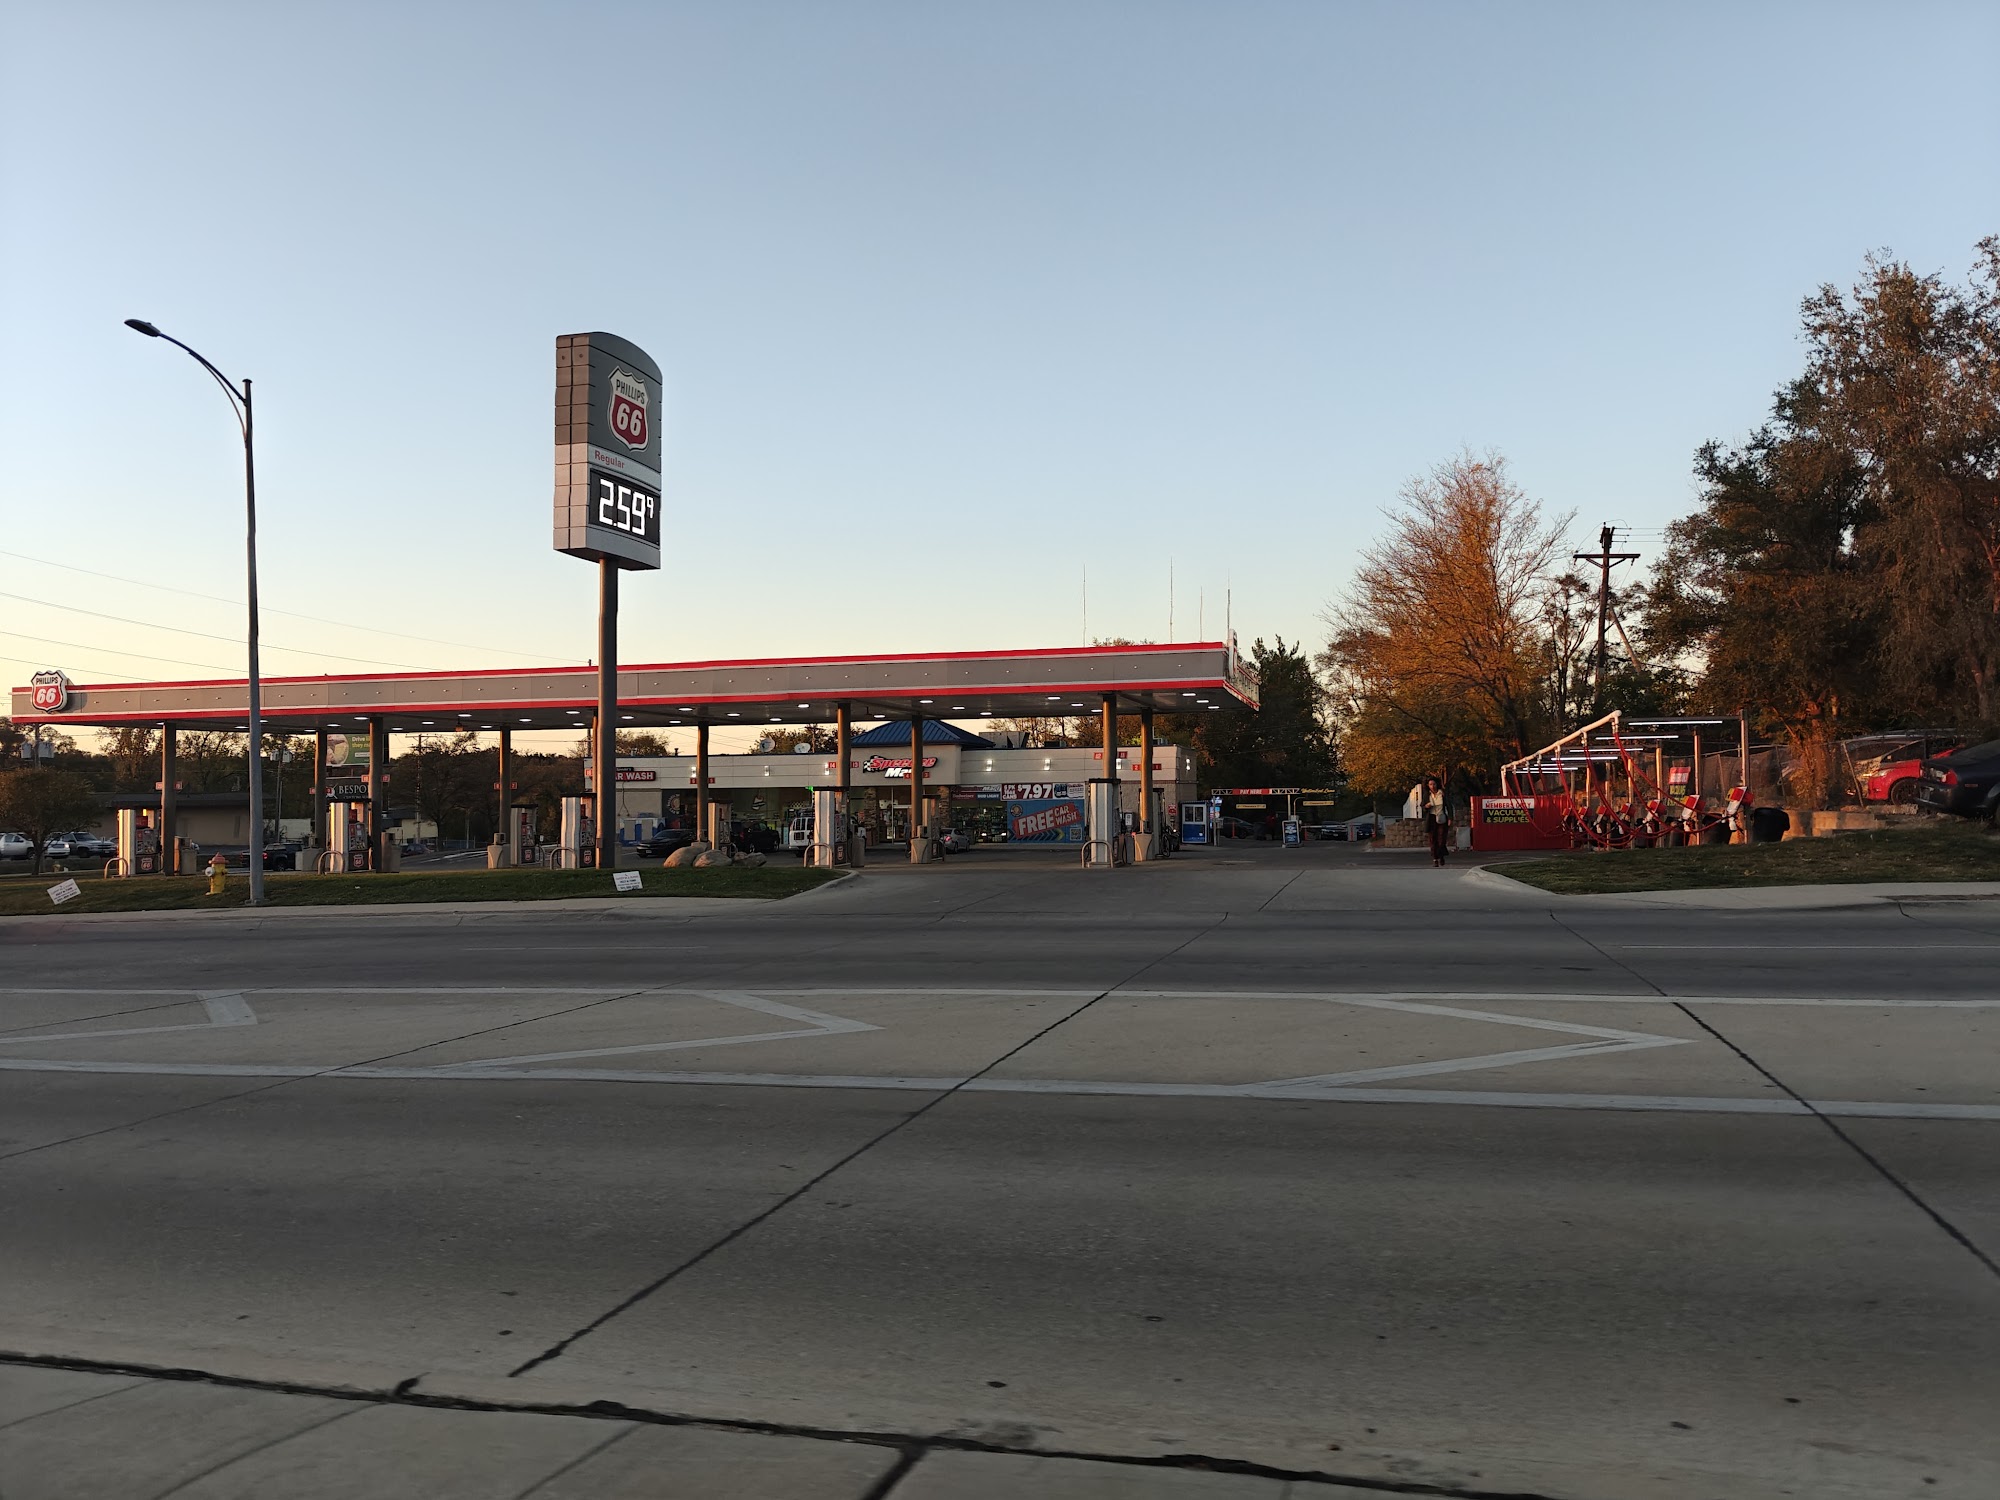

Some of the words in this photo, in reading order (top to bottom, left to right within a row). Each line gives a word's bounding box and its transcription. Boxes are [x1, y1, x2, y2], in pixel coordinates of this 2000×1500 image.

[615, 378, 646, 405] PHILLIPS
[616, 402, 643, 437] 66
[594, 450, 625, 470] Regular
[36, 676, 59, 685] PHILLIPS
[36, 687, 57, 704] 66
[626, 772, 654, 780] WASH
[338, 784, 368, 795] BESPO
[1017, 783, 1052, 799] $7.97
[1054, 805, 1070, 817] CAR
[1055, 811, 1078, 825] WASH
[1018, 810, 1055, 835] FREE
